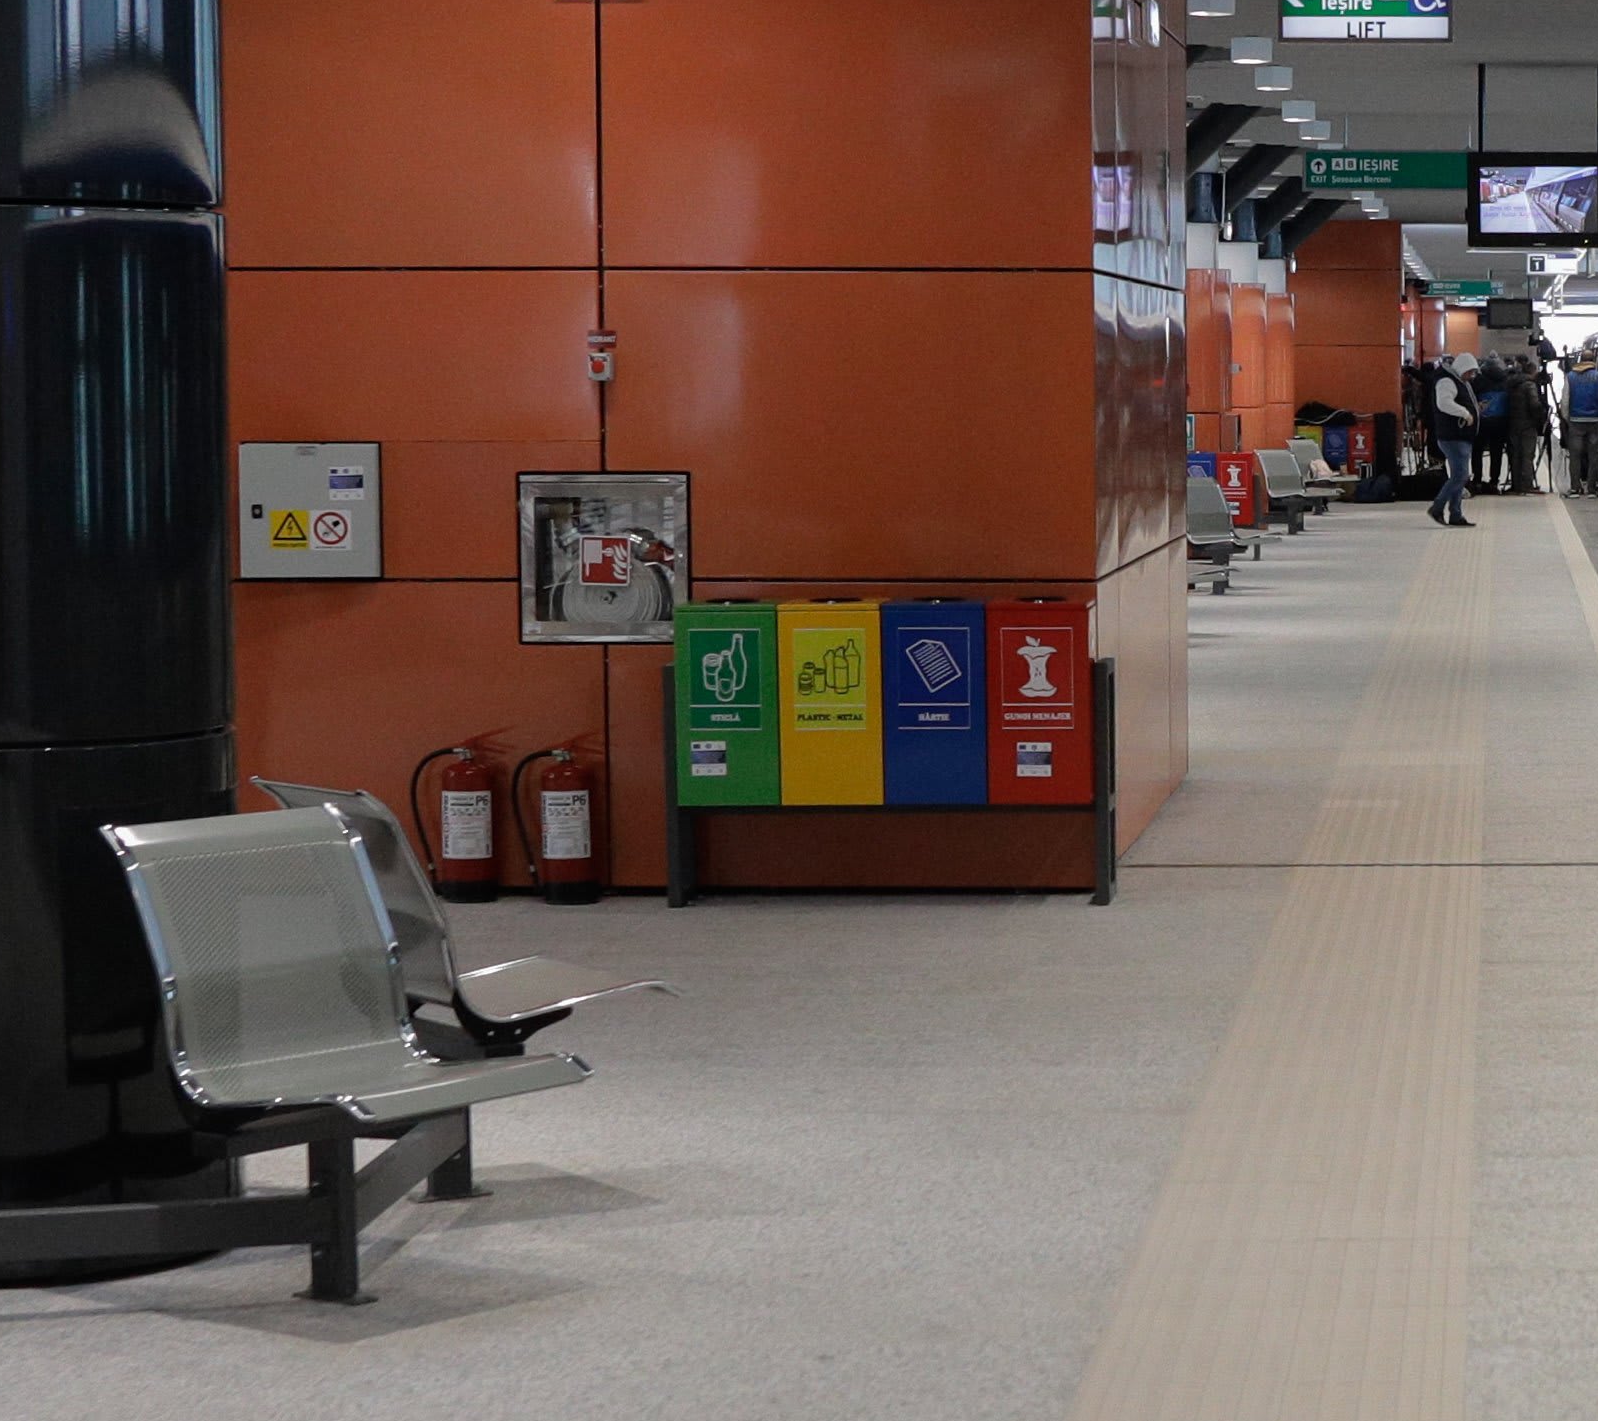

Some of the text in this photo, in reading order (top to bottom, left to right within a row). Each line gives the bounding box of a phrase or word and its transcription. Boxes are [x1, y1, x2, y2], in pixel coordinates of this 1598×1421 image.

[1346, 21, 1386, 39] LIFT
[1359, 159, 1400, 174] IEȘIRE
[572, 795, 586, 805] P6
